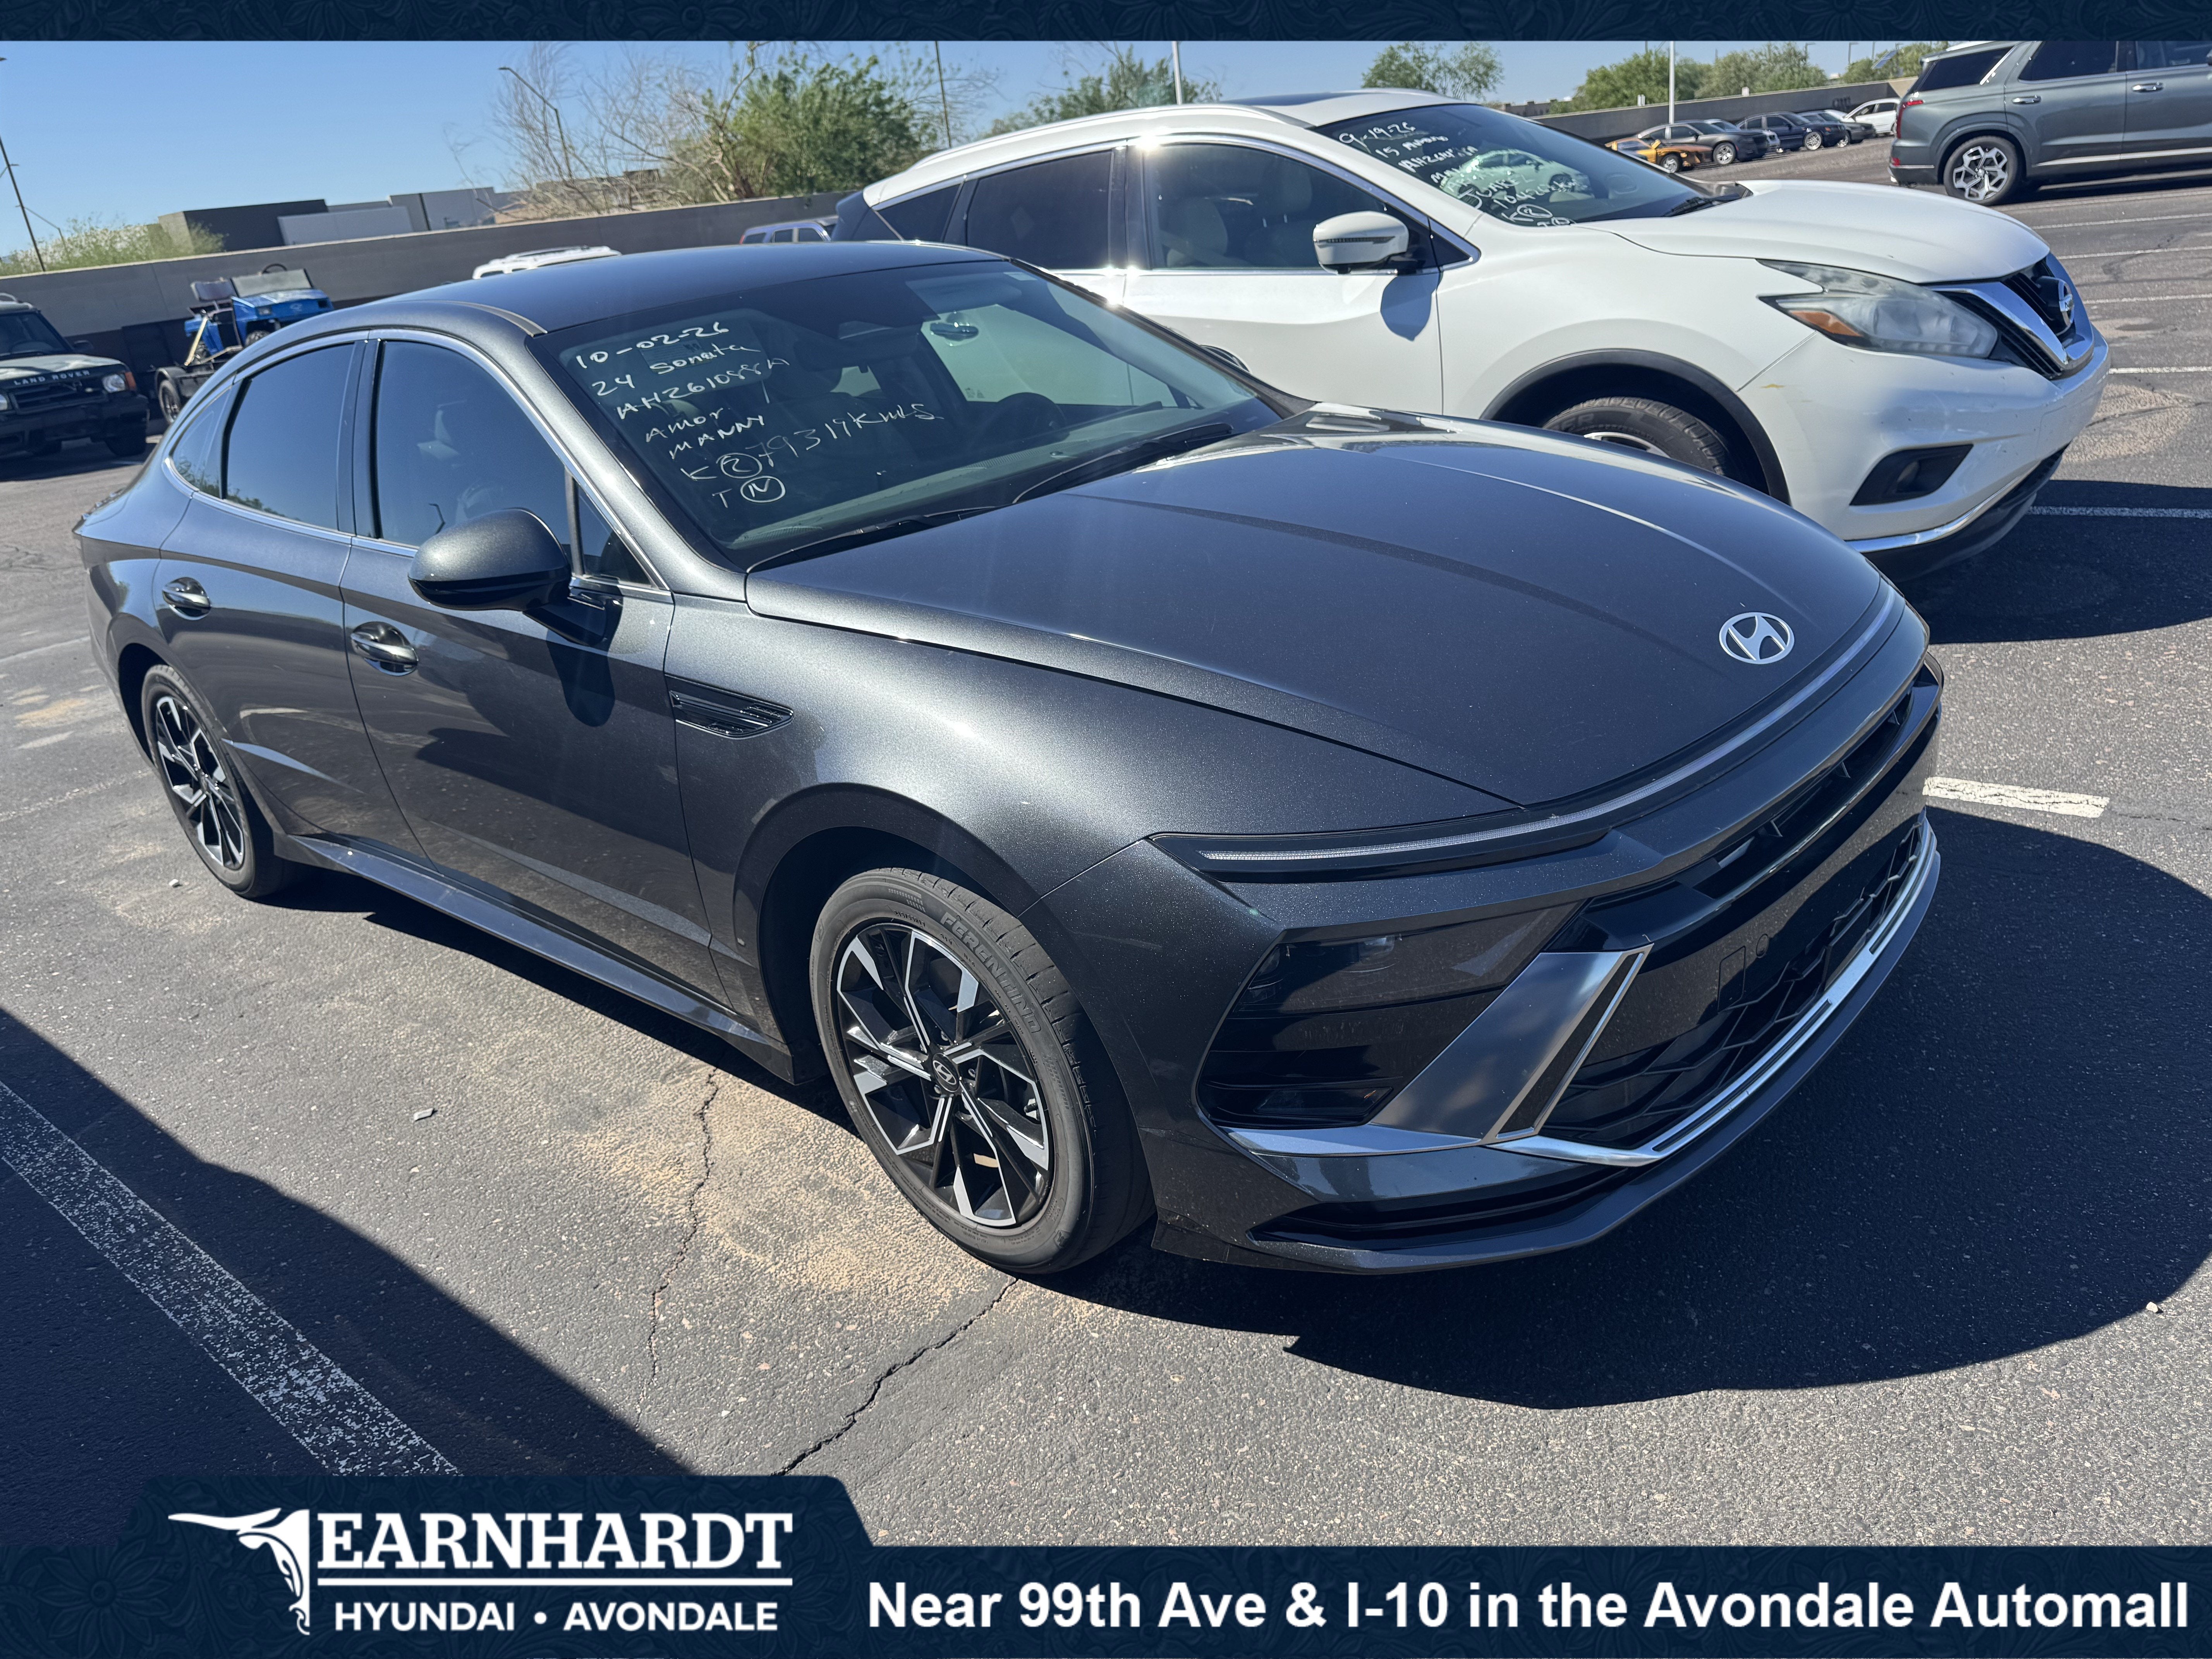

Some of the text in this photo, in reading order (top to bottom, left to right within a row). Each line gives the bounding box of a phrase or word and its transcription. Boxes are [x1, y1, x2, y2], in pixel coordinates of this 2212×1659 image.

[1375, 146, 1400, 158] 15
[576, 321, 729, 369] 10-02-26
[14, 369, 90, 386] LAND ROVER
[592, 374, 635, 396] 24
[649, 343, 761, 374] Sonata
[669, 415, 765, 460] MANNY
[680, 465, 718, 481] K
[712, 488, 733, 508] T
